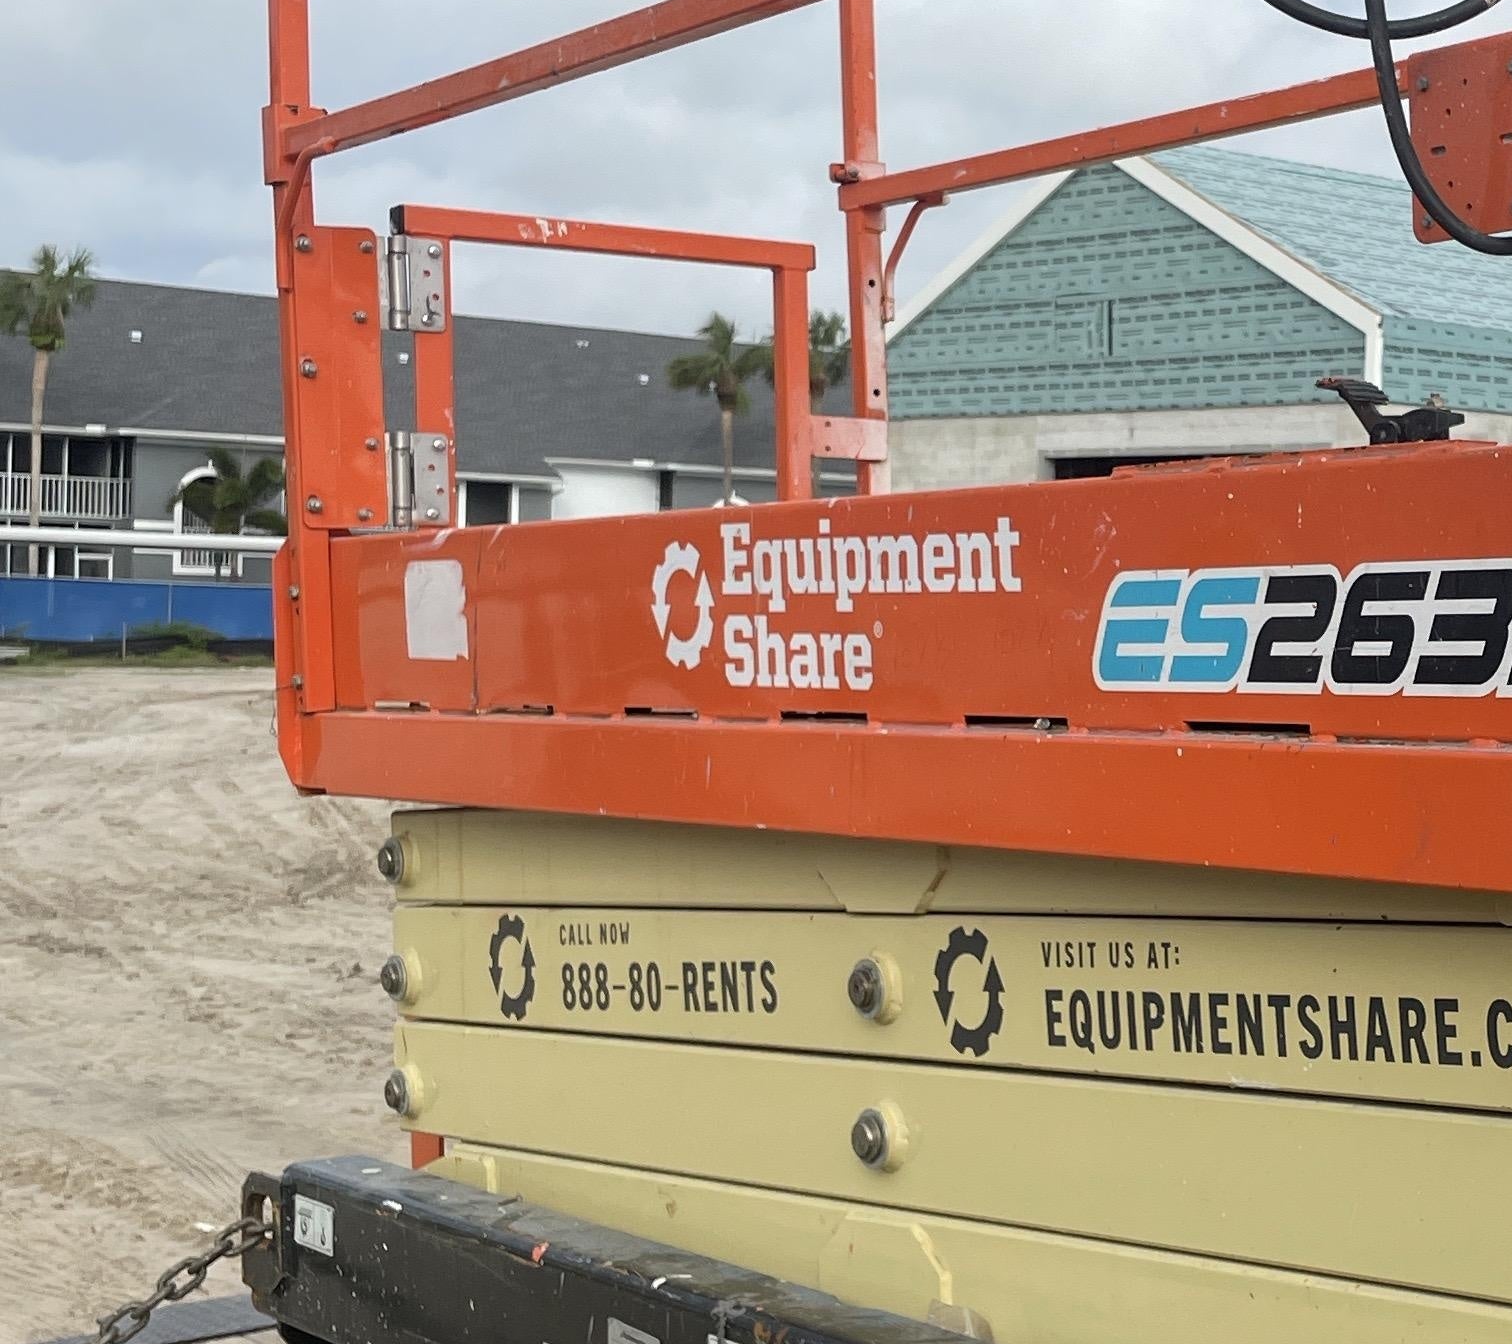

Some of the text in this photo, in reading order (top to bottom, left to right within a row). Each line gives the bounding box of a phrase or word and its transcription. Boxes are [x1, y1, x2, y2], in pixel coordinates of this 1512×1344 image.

[719, 515, 1023, 613] Equipment
[559, 921, 631, 946] CALL NOW
[1041, 940, 1181, 970] VISIT US AT:
[561, 959, 779, 1015] 888-80-RENTS
